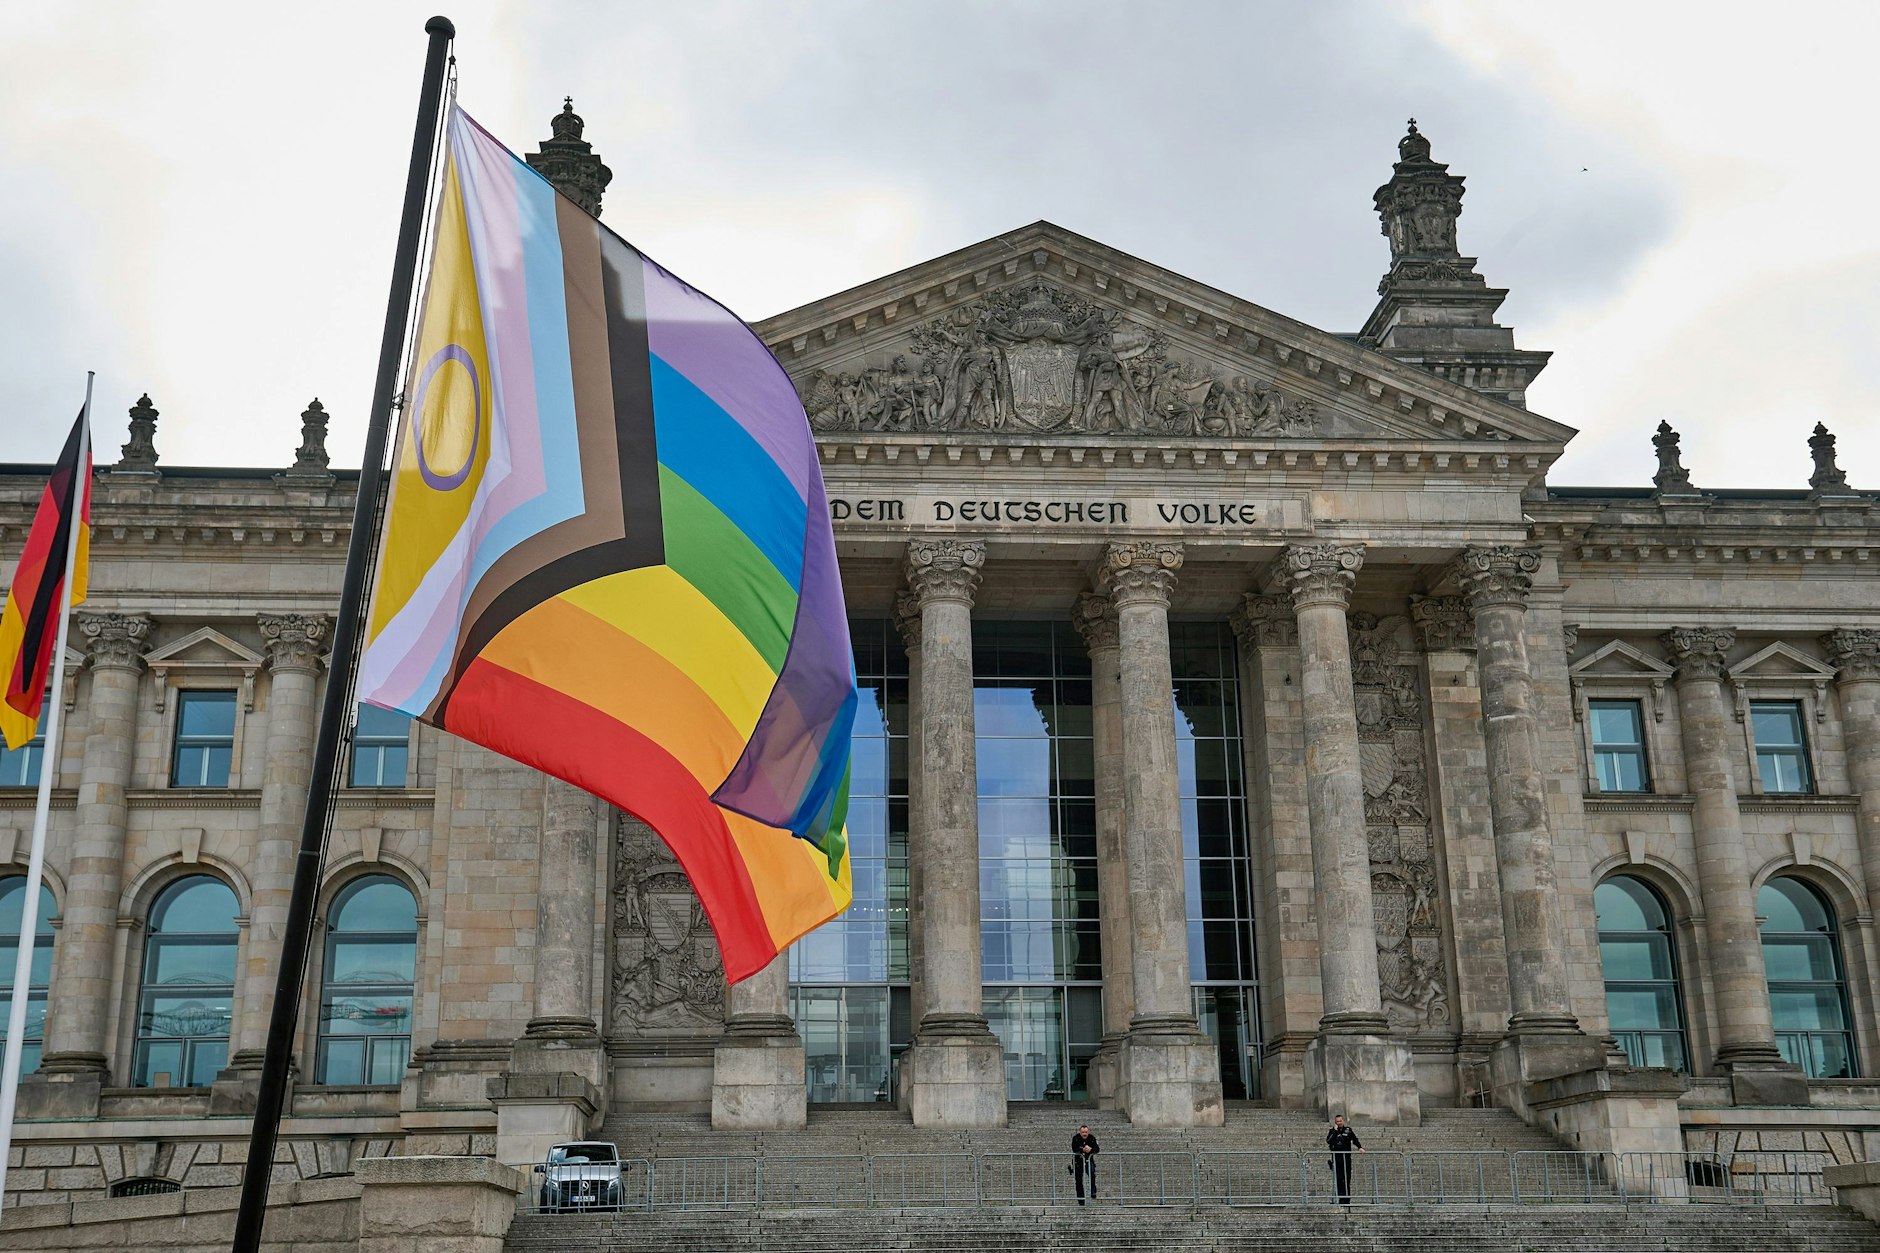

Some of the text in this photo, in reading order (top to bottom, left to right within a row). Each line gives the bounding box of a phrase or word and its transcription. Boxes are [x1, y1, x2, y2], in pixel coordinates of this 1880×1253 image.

[829, 499, 1257, 525] DEM DEUTSCHEN VOLKE
